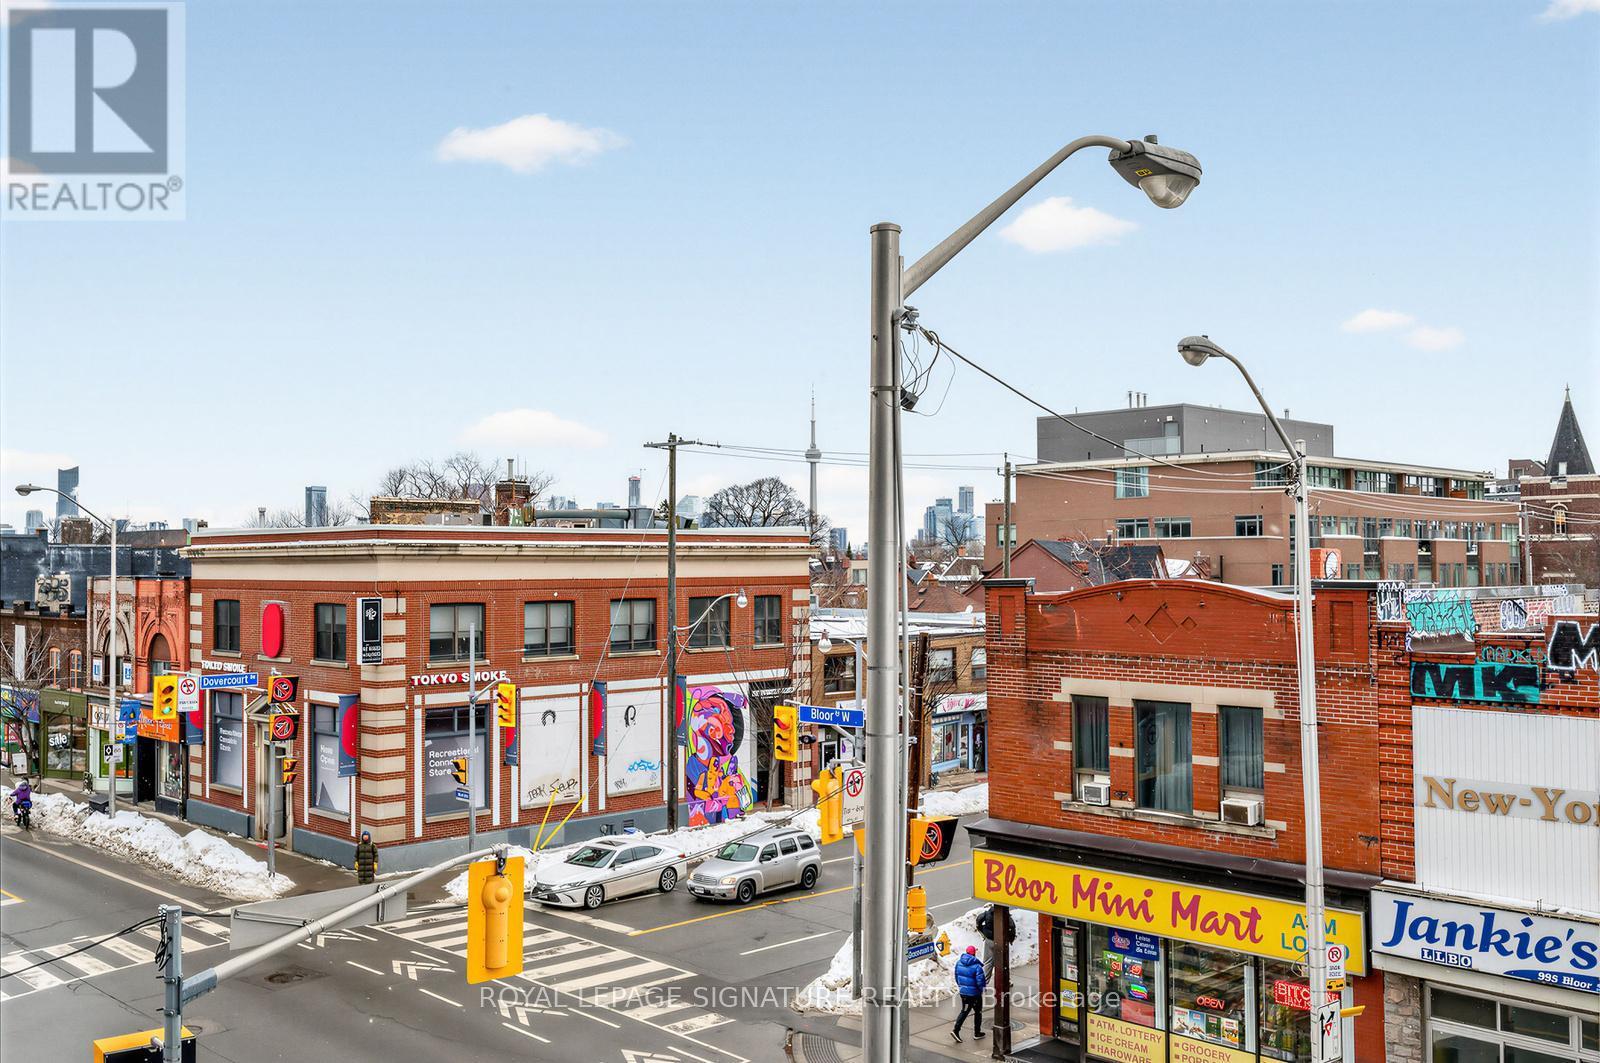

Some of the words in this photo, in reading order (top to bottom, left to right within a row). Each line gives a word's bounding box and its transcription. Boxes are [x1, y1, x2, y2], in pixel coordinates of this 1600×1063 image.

[203, 674, 249, 687] Dovercourt
[411, 673, 458, 686] TOKYO
[811, 708, 834, 721] Bloor
[841, 711, 850, 722] W
[49, 733, 68, 747] sale
[429, 768, 451, 777] Store
[984, 858, 1058, 905] Bloor
[1072, 874, 1154, 923] Mini
[1171, 891, 1263, 944] Mart
[1292, 913, 1336, 935] AM
[1382, 899, 1598, 970] Jankie's
[1421, 948, 1473, 969] LLBO
[1562, 975, 1593, 989] Bloor
[1196, 995, 1225, 1010] OPEN
[1120, 1026, 1162, 1044] LOTTERY
[1097, 1033, 1113, 1044] ICE
[1115, 1037, 1149, 1054] CREAM
[1181, 1042, 1232, 1062] GROCERY
